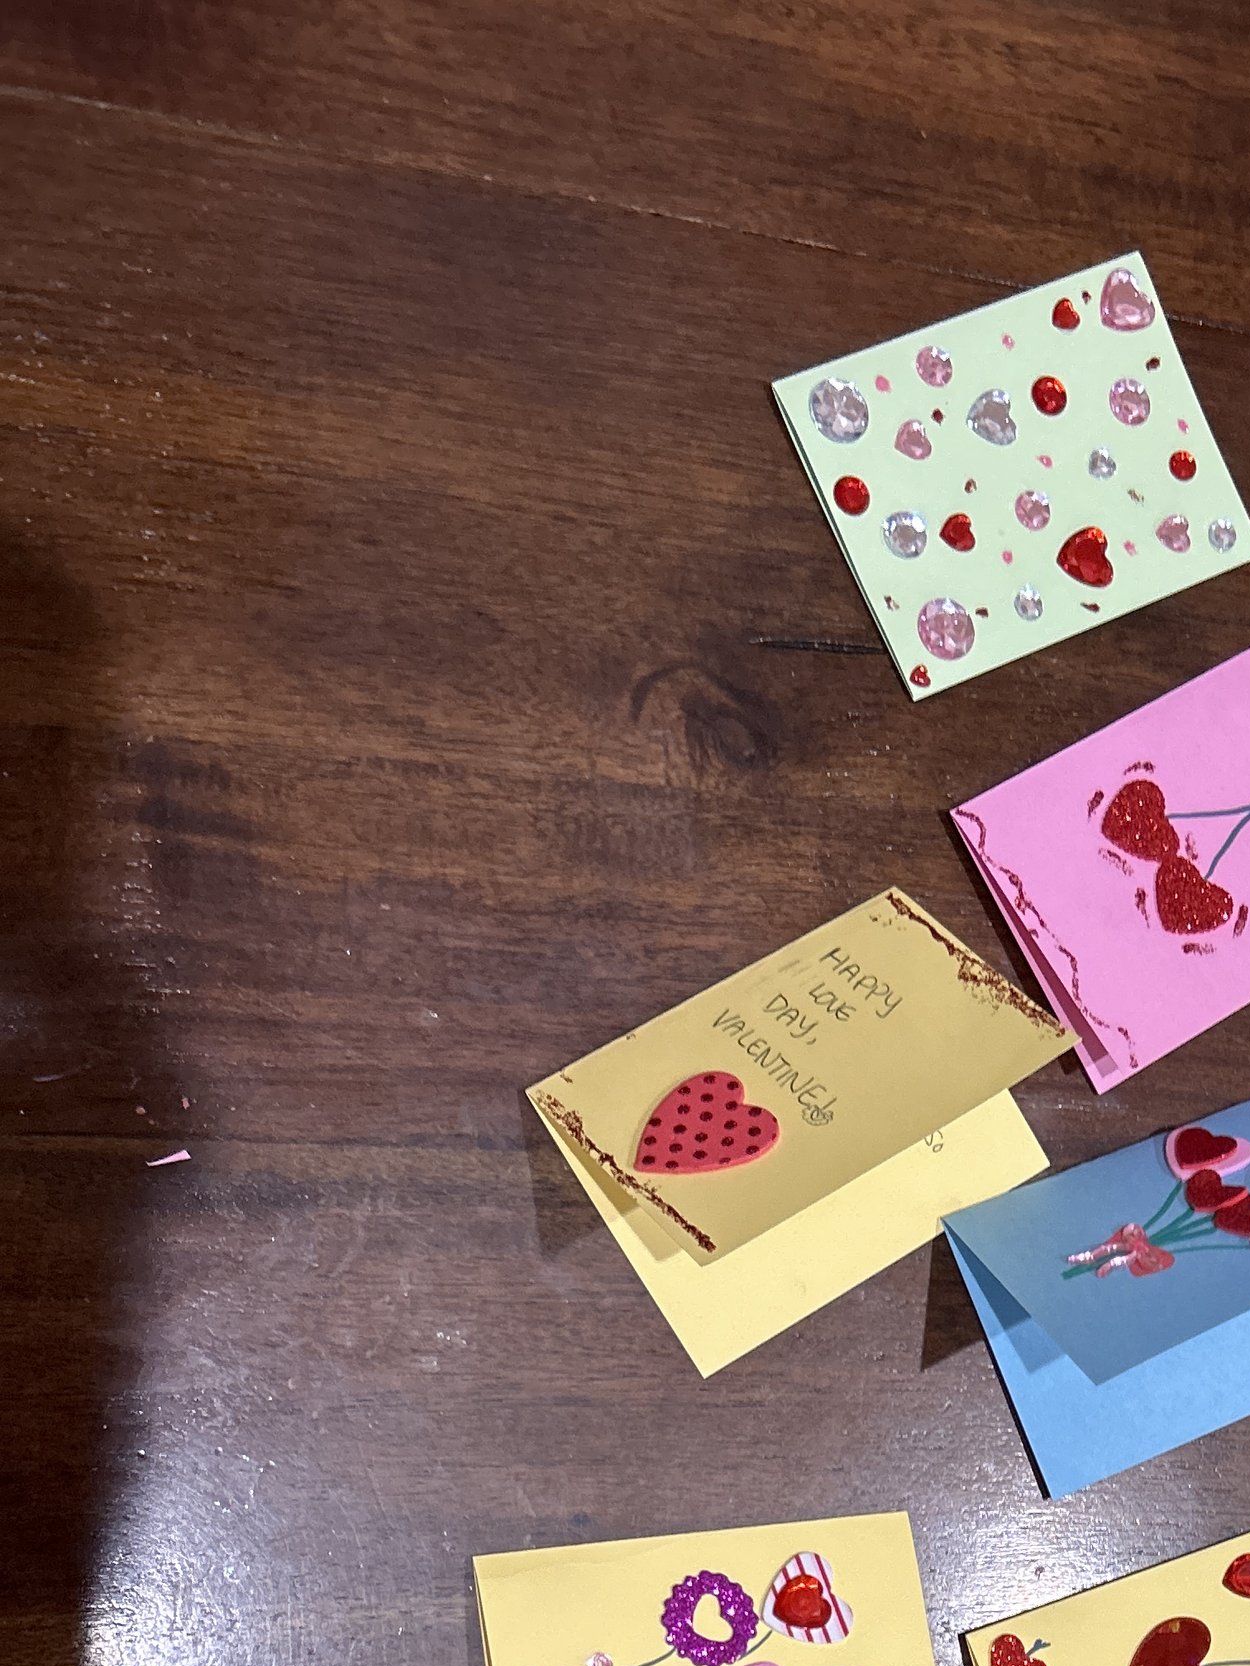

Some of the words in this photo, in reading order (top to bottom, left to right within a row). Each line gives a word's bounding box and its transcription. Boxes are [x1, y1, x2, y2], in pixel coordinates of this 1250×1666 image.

[808, 982, 856, 1022] LOVE
[818, 947, 903, 1019] HAPPY
[762, 993, 819, 1045] DAY,
